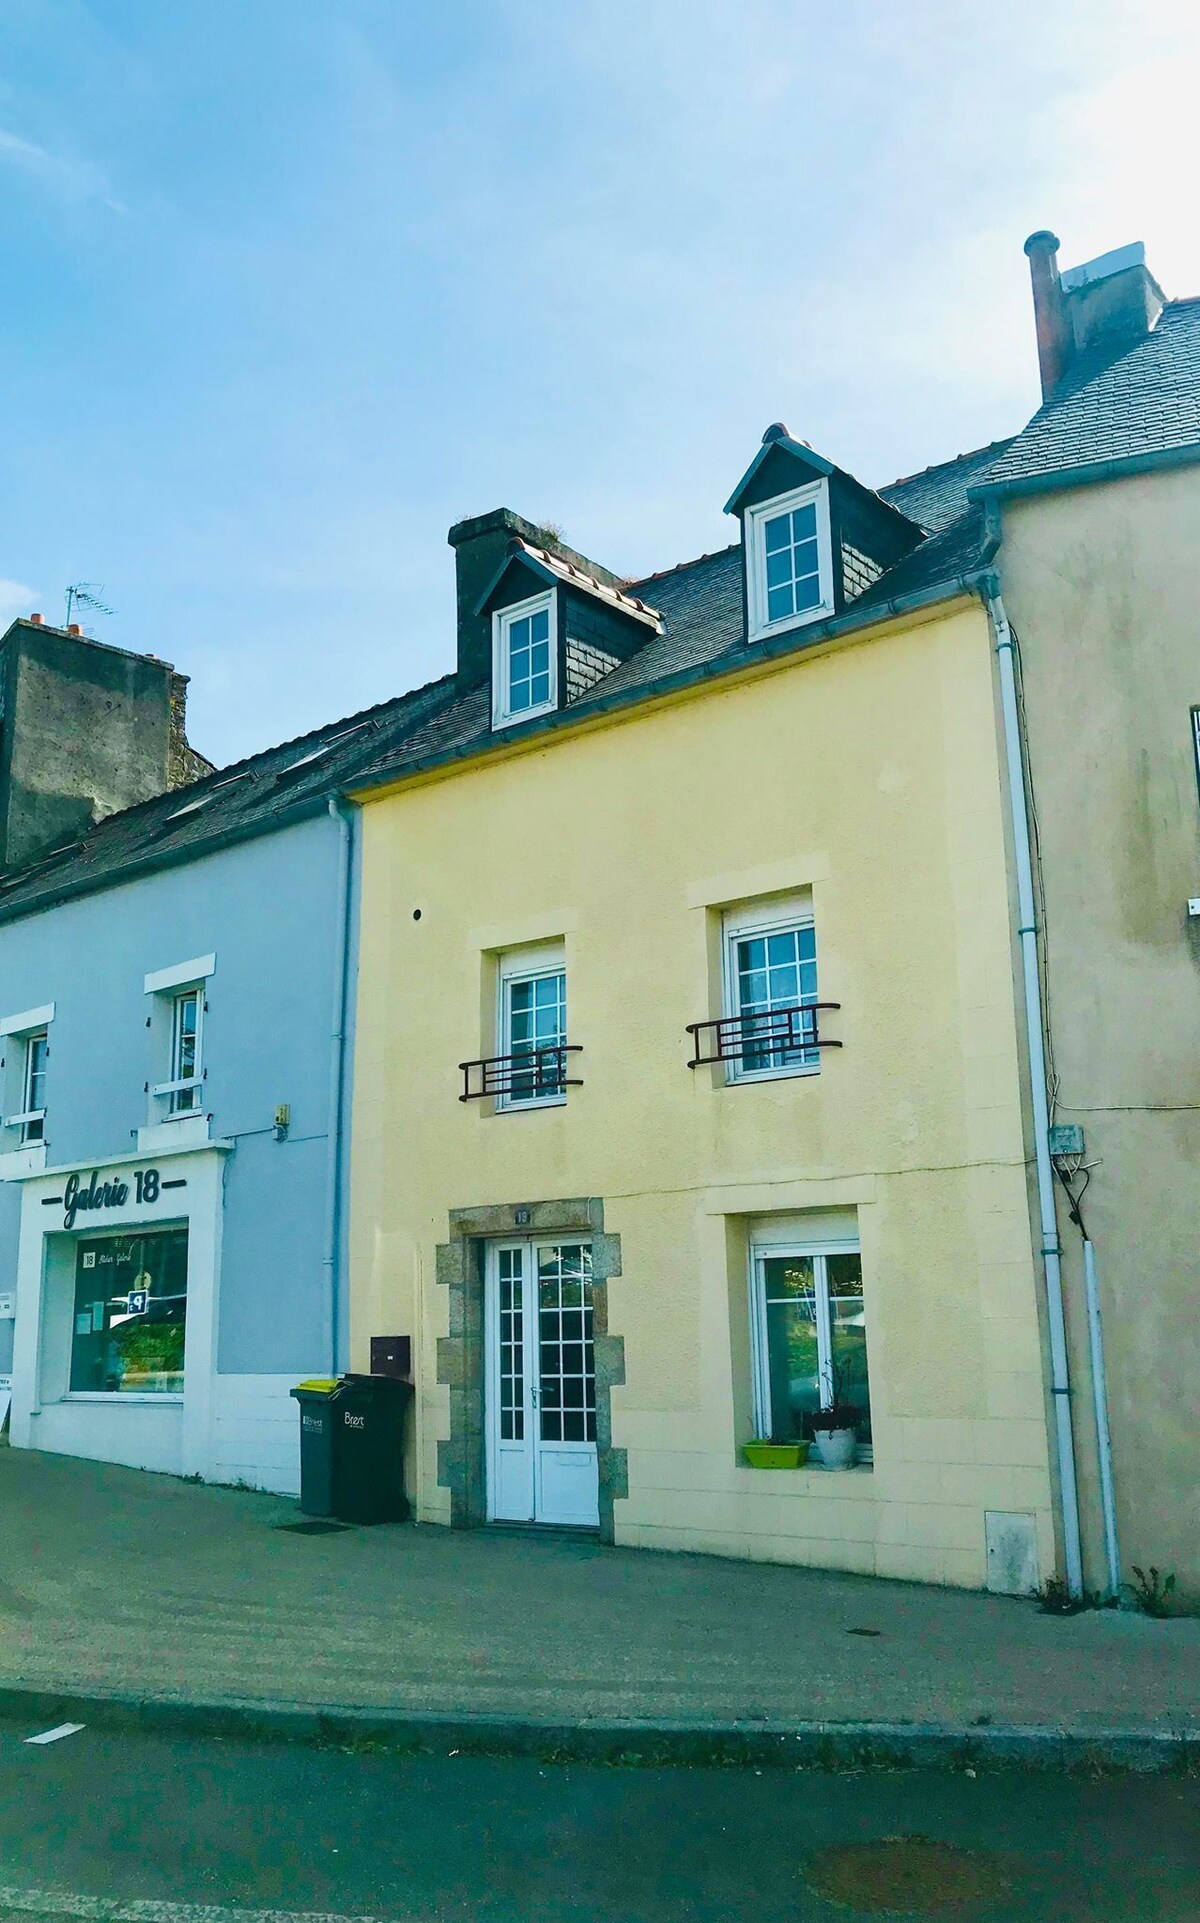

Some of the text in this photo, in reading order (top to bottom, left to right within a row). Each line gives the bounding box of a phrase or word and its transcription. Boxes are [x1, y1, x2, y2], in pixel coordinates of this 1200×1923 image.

[64, 1168, 160, 1229] Galerie 18
[86, 1255, 93, 1266] 18
[344, 1411, 365, 1426] Brest
